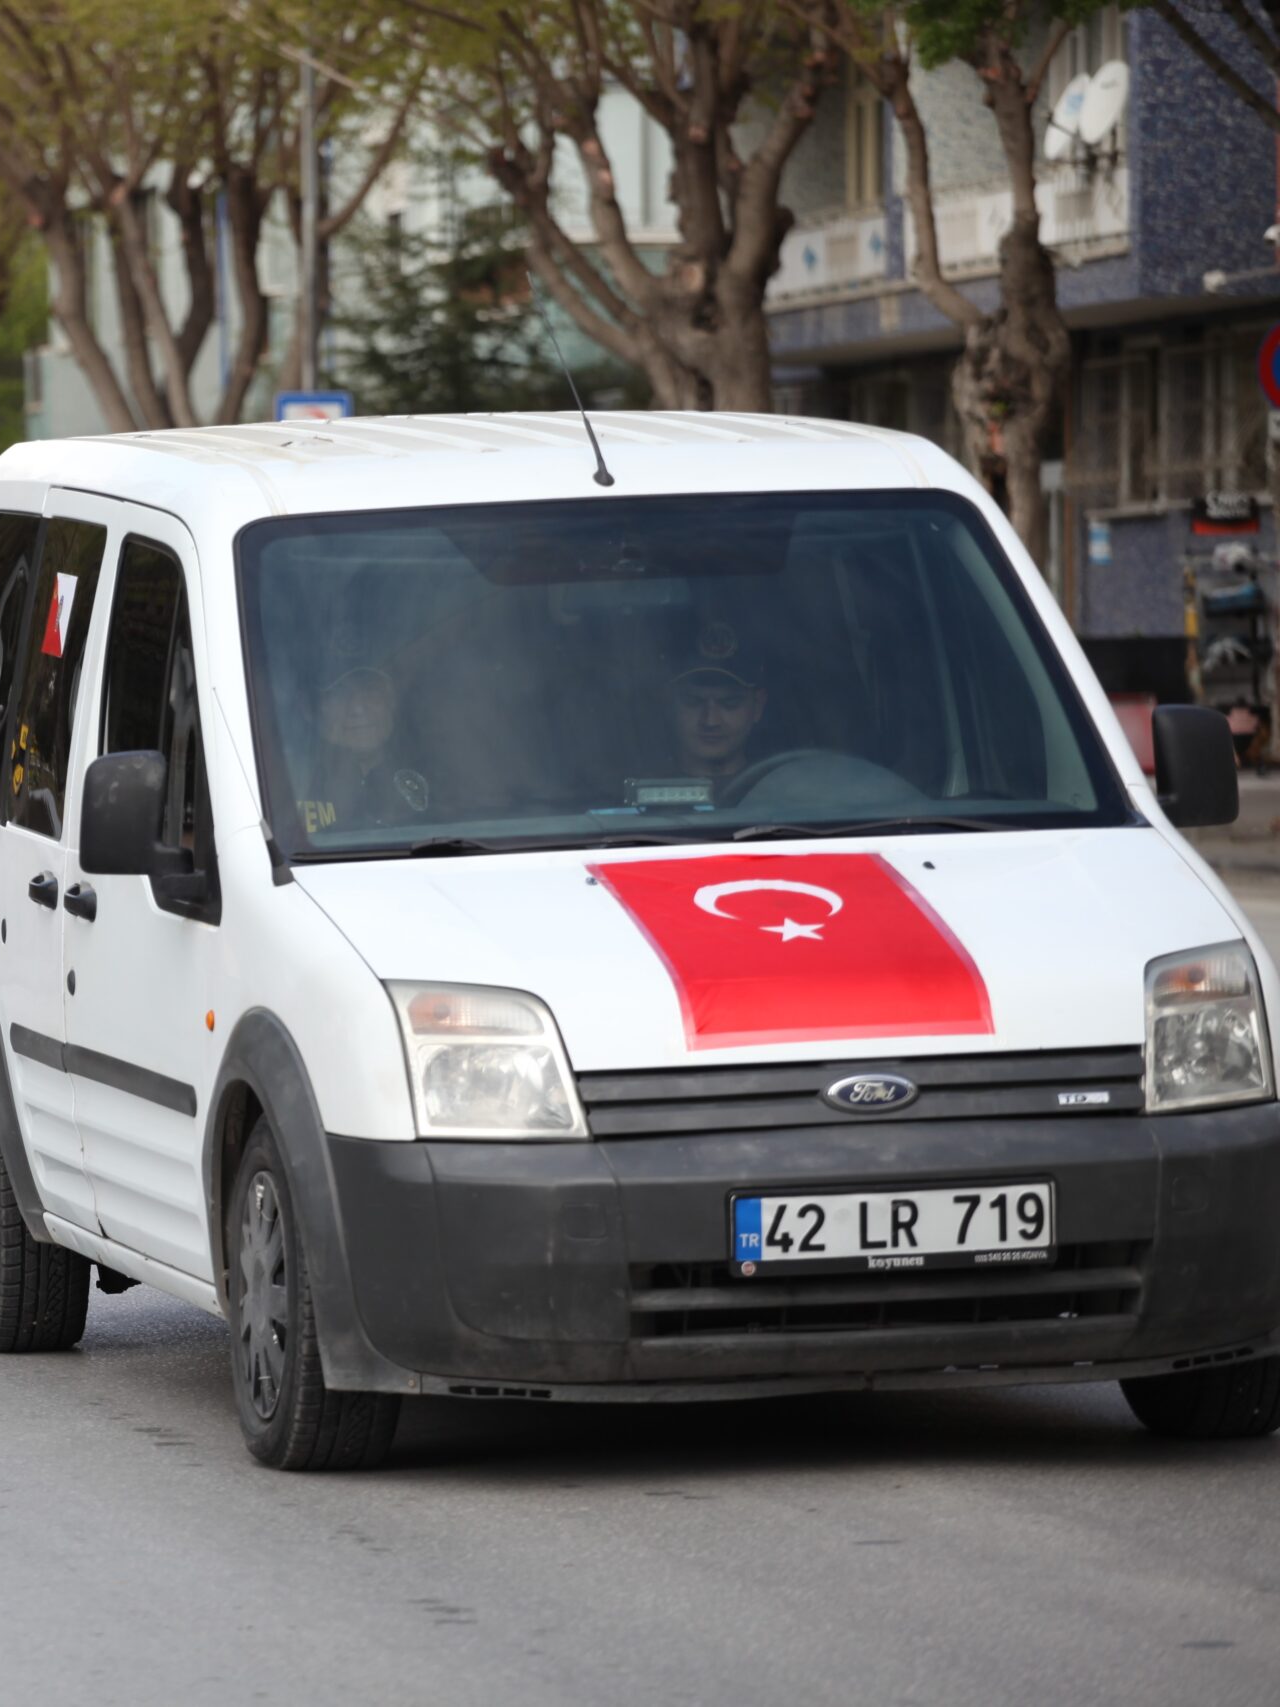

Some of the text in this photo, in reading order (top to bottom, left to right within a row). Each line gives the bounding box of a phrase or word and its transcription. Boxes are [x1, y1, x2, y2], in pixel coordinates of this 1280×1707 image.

[849, 1081, 896, 1103] Ford
[739, 1192, 1045, 1253] TR 42 LR 719
